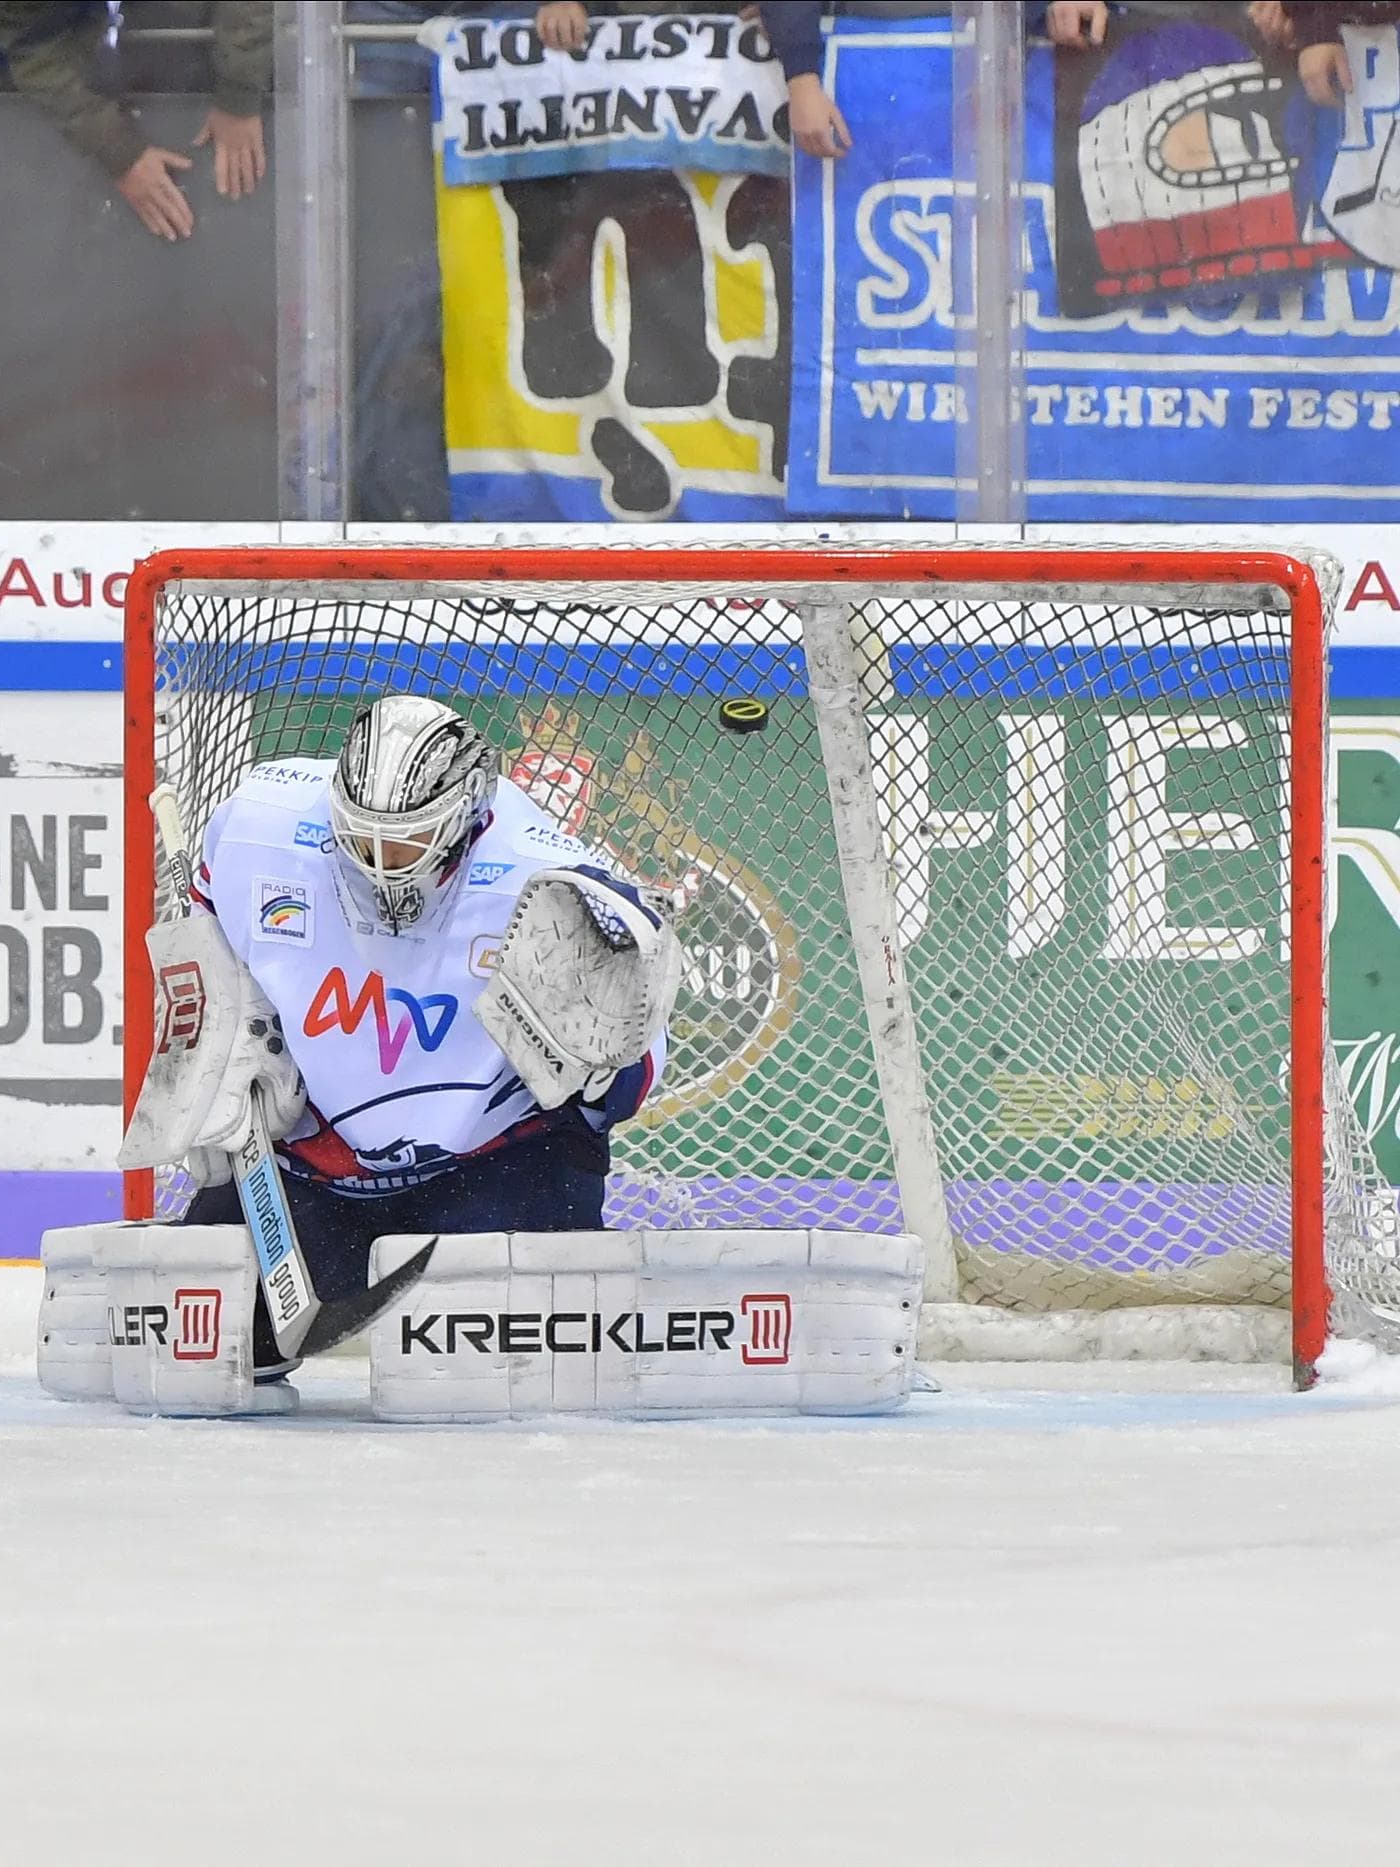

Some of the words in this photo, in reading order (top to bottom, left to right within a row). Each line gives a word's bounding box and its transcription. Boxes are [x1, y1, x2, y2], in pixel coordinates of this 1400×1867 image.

[852, 379, 968, 424] WIR
[1011, 384, 1230, 429] TEHEN
[1248, 386, 1400, 430] FEST
[264, 883, 306, 897] RADIO
[470, 865, 505, 882] SAP
[497, 991, 564, 1075] VAUGHN
[268, 1262, 301, 1322] group
[401, 1310, 735, 1355] KRECKLER
